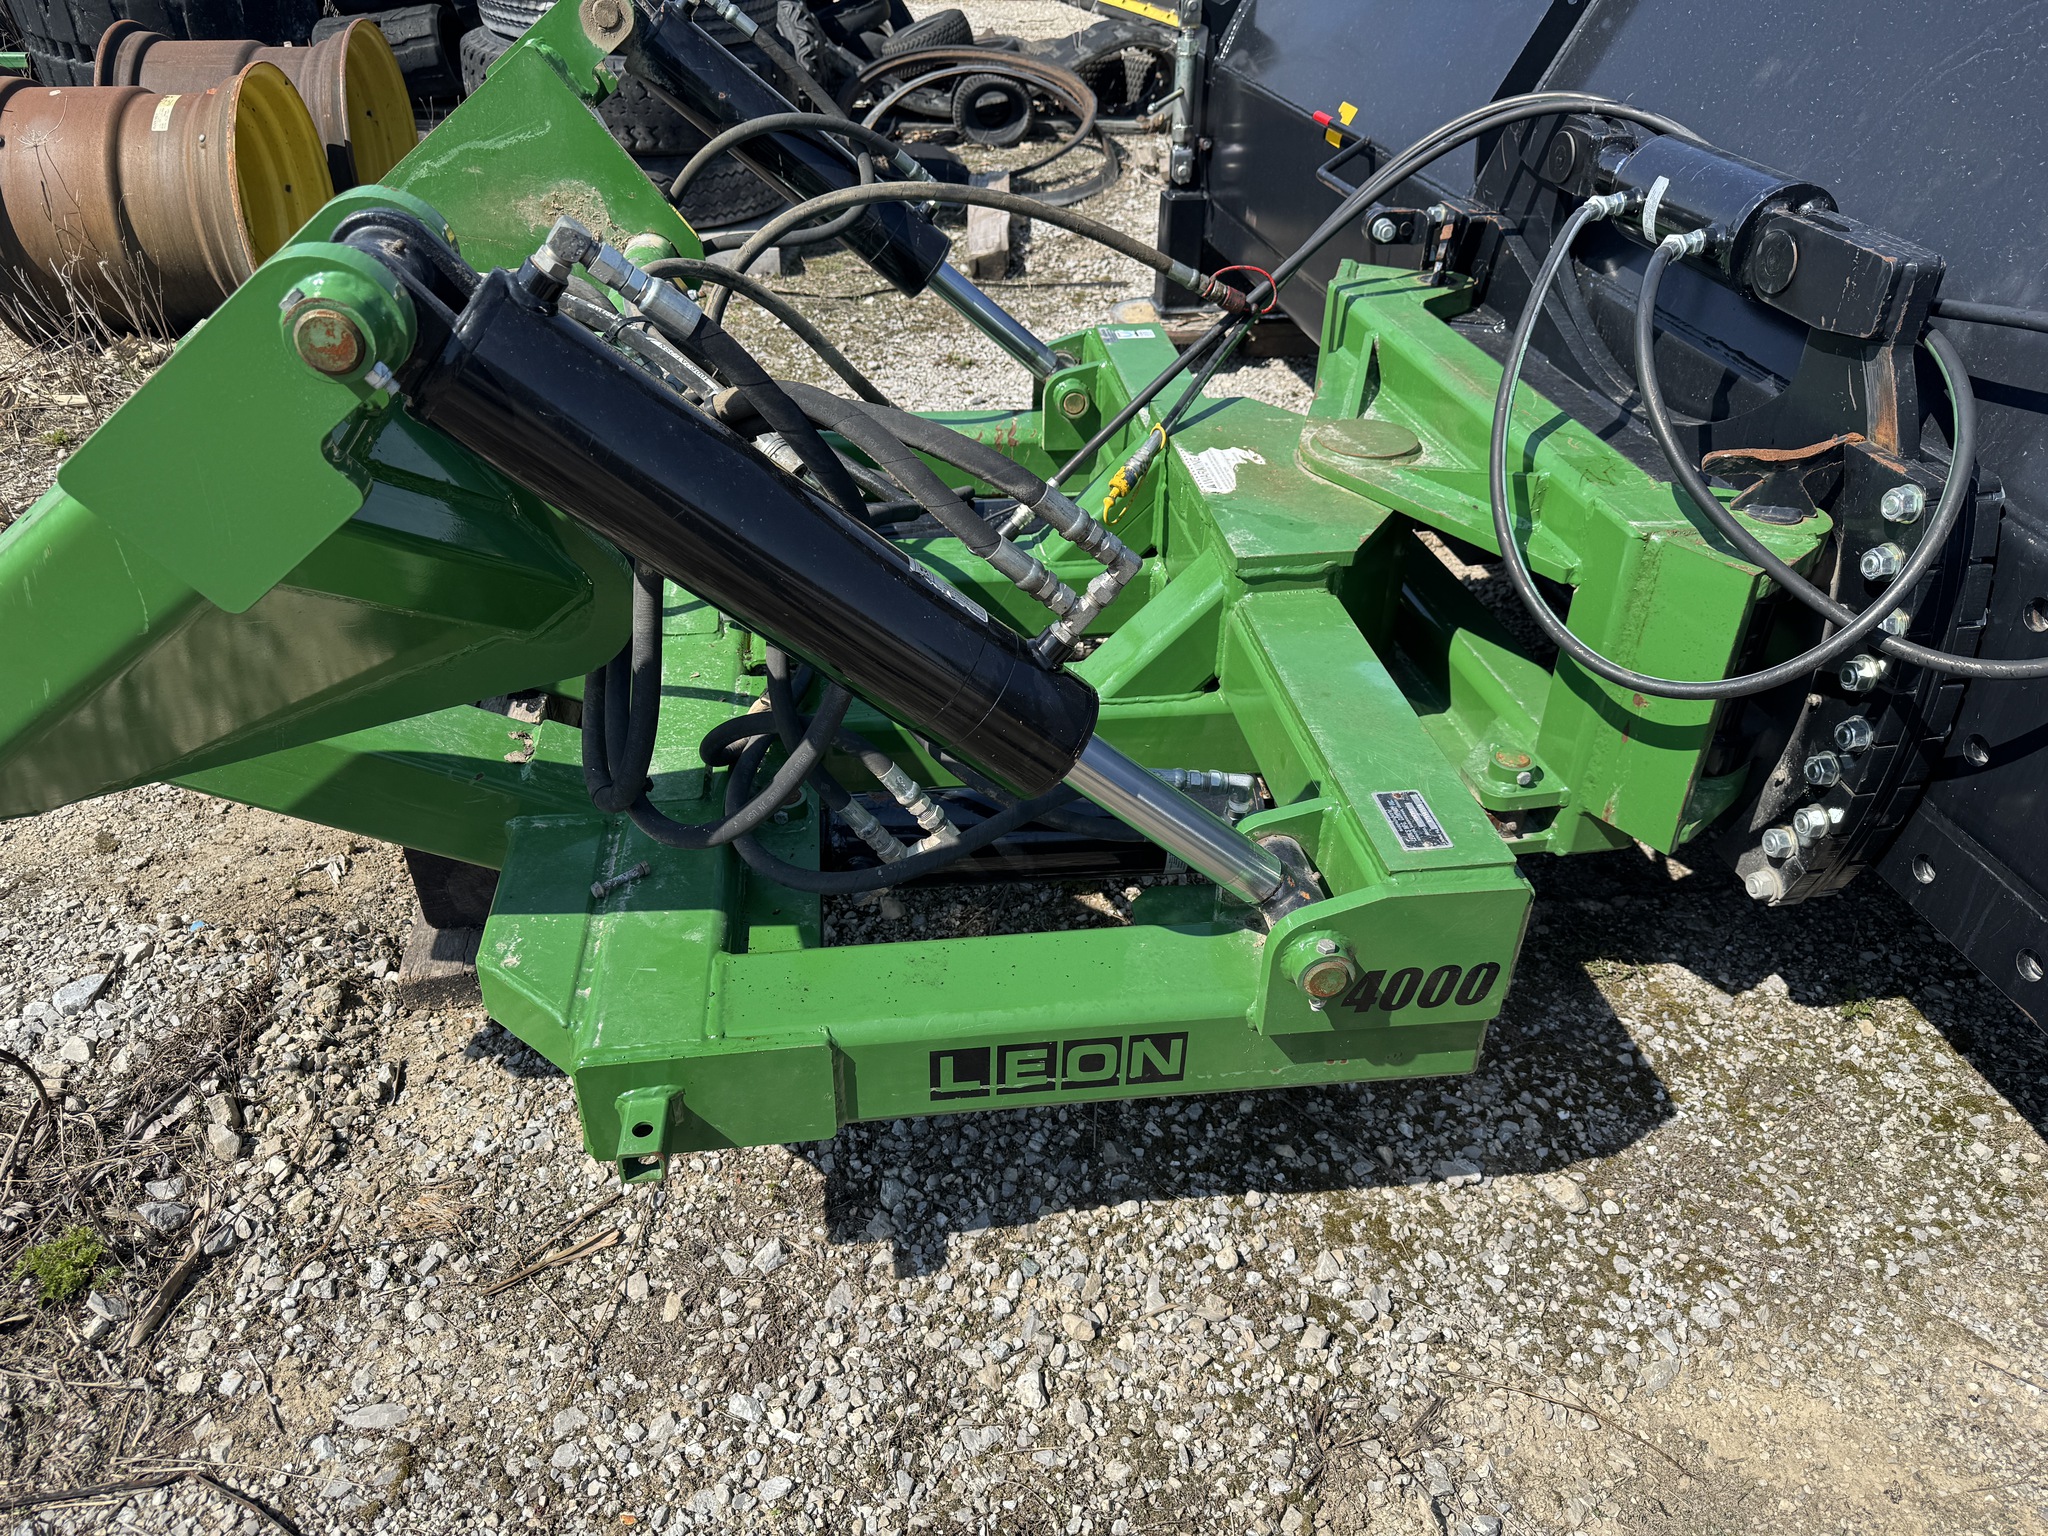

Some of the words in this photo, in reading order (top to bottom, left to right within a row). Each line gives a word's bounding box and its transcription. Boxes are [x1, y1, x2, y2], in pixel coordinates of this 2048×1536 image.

[745, 808, 760, 822] USA
[1341, 962, 1501, 1013] 4000
[929, 1032, 1189, 1101] LEON
